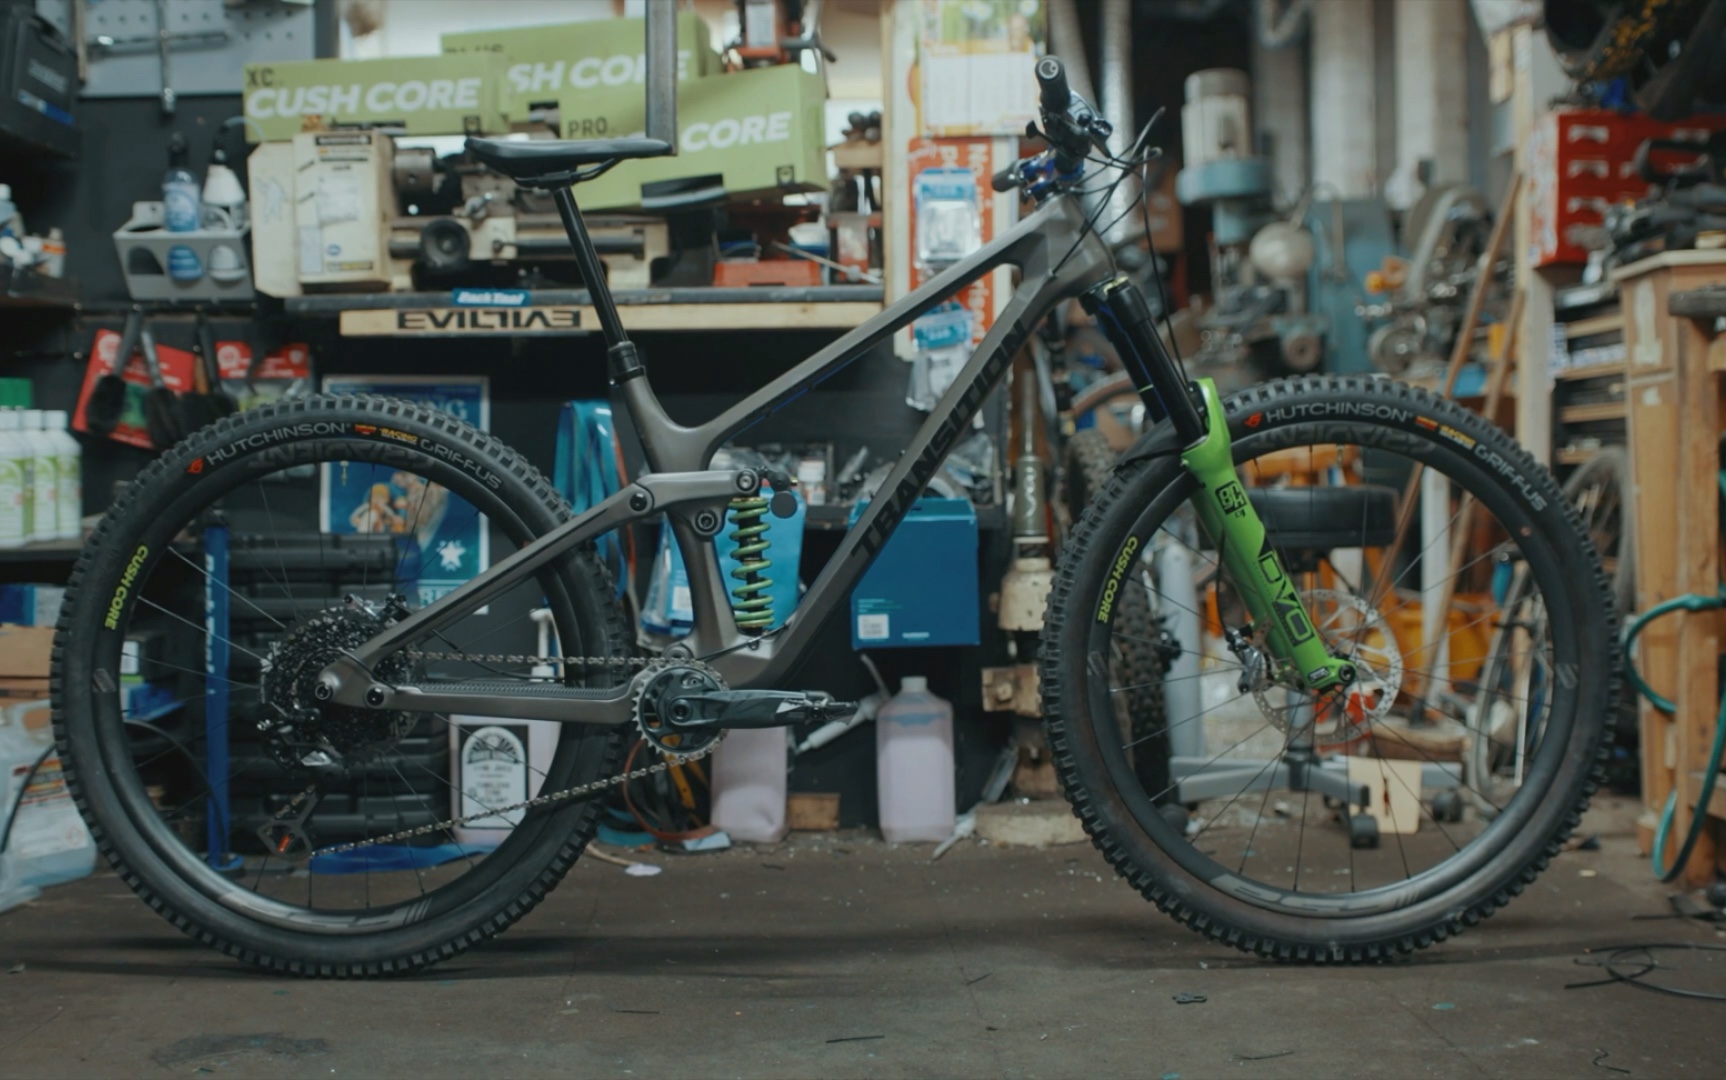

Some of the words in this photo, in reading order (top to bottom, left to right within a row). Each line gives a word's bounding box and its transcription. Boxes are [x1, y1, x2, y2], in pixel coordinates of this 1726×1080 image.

[246, 67, 274, 87] XC
[247, 83, 361, 119] CUSH
[365, 77, 482, 113] CORE
[568, 117, 608, 138] PRO
[681, 112, 792, 152] CORE
[206, 422, 346, 465] HUTCHINSON
[420, 439, 502, 490] GRIFFUS
[851, 318, 1031, 559] TRANSITION
[1265, 402, 1407, 423] HUTCHINSON
[1474, 444, 1548, 511] GRIFFUS
[121, 545, 149, 588] CUSH
[1112, 536, 1138, 580] CUSH
[104, 586, 127, 630] CORE
[1098, 579, 1118, 623] CORE
[1257, 551, 1315, 647] DVO
